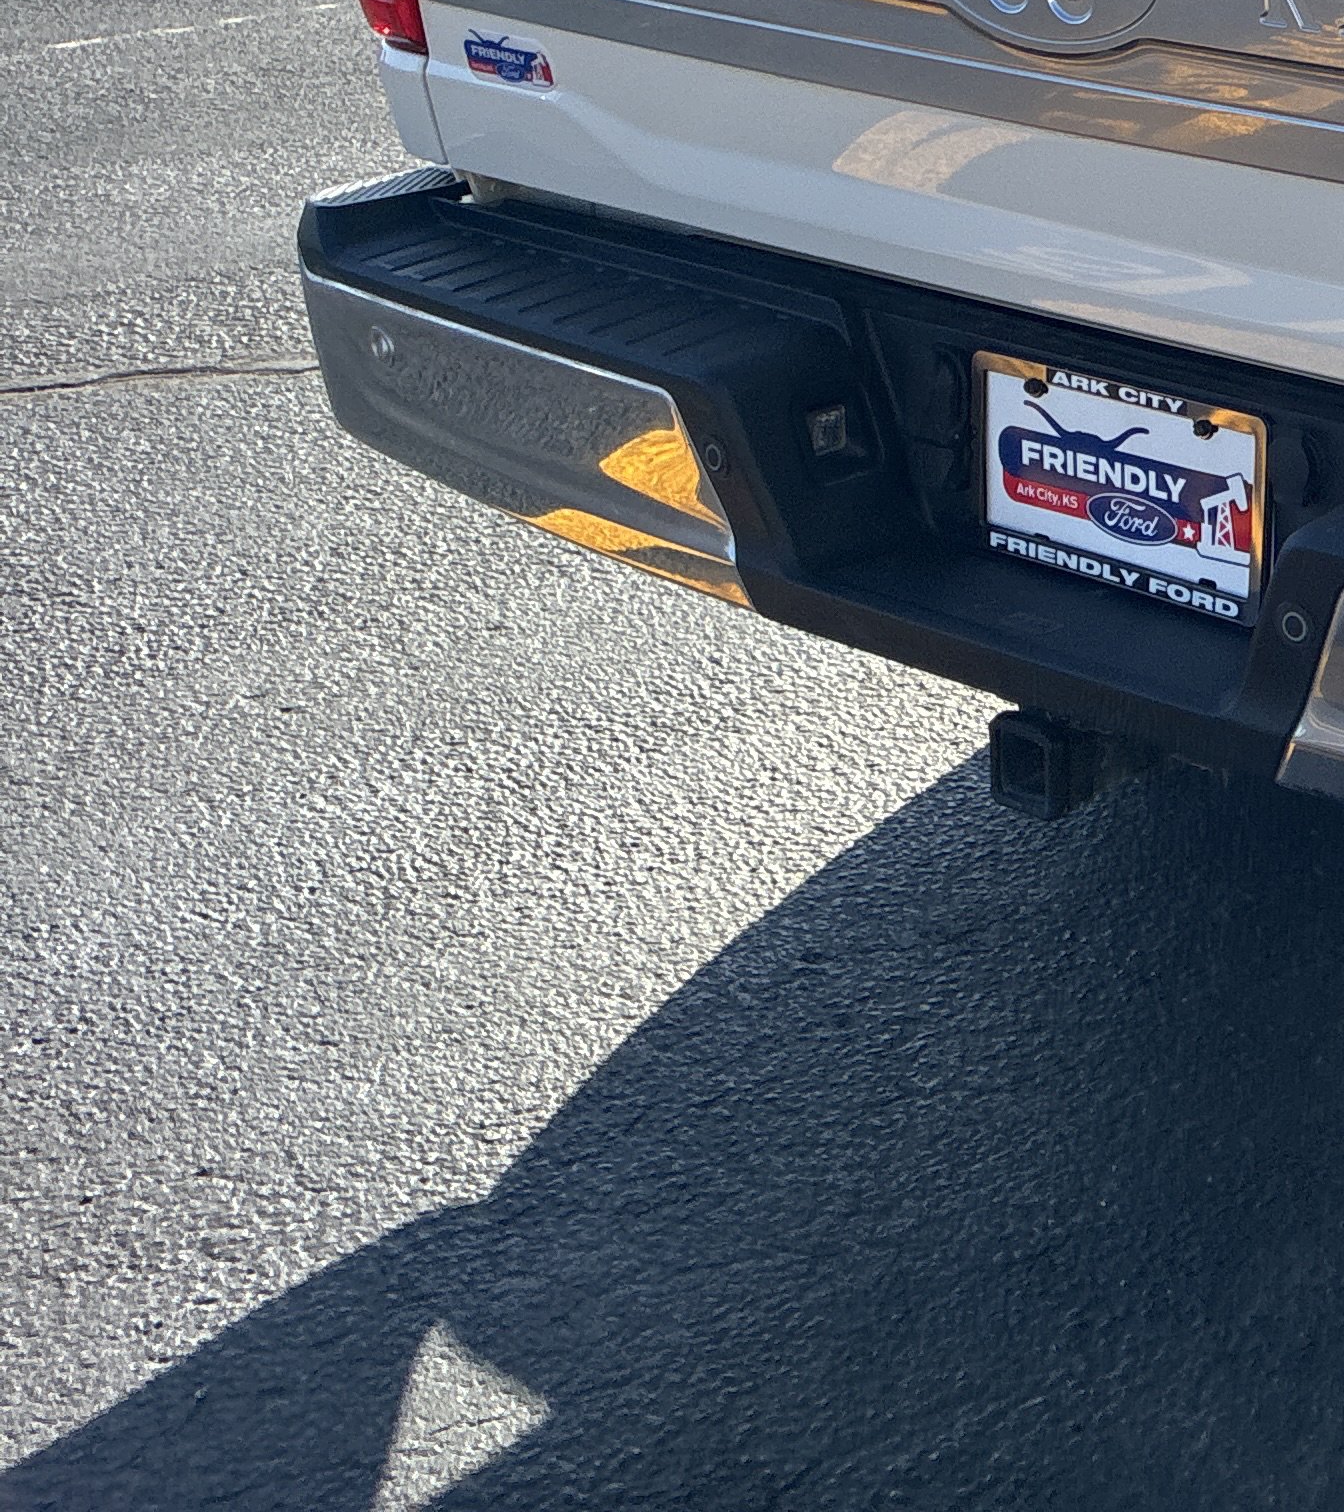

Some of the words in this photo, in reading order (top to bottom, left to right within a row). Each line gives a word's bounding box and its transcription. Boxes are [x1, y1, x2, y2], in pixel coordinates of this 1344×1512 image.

[470, 44, 525, 65] FRIENDLY
[1051, 371, 1109, 396] ARK
[1117, 384, 1185, 414] CITY
[1020, 439, 1187, 504] FRIENDLY
[1016, 483, 1035, 498] Ark
[1036, 487, 1061, 506] City,
[1062, 494, 1079, 509] KS
[1103, 497, 1160, 538] Ford
[989, 532, 1141, 587] FRIENDLY
[1148, 579, 1240, 618] FORD
